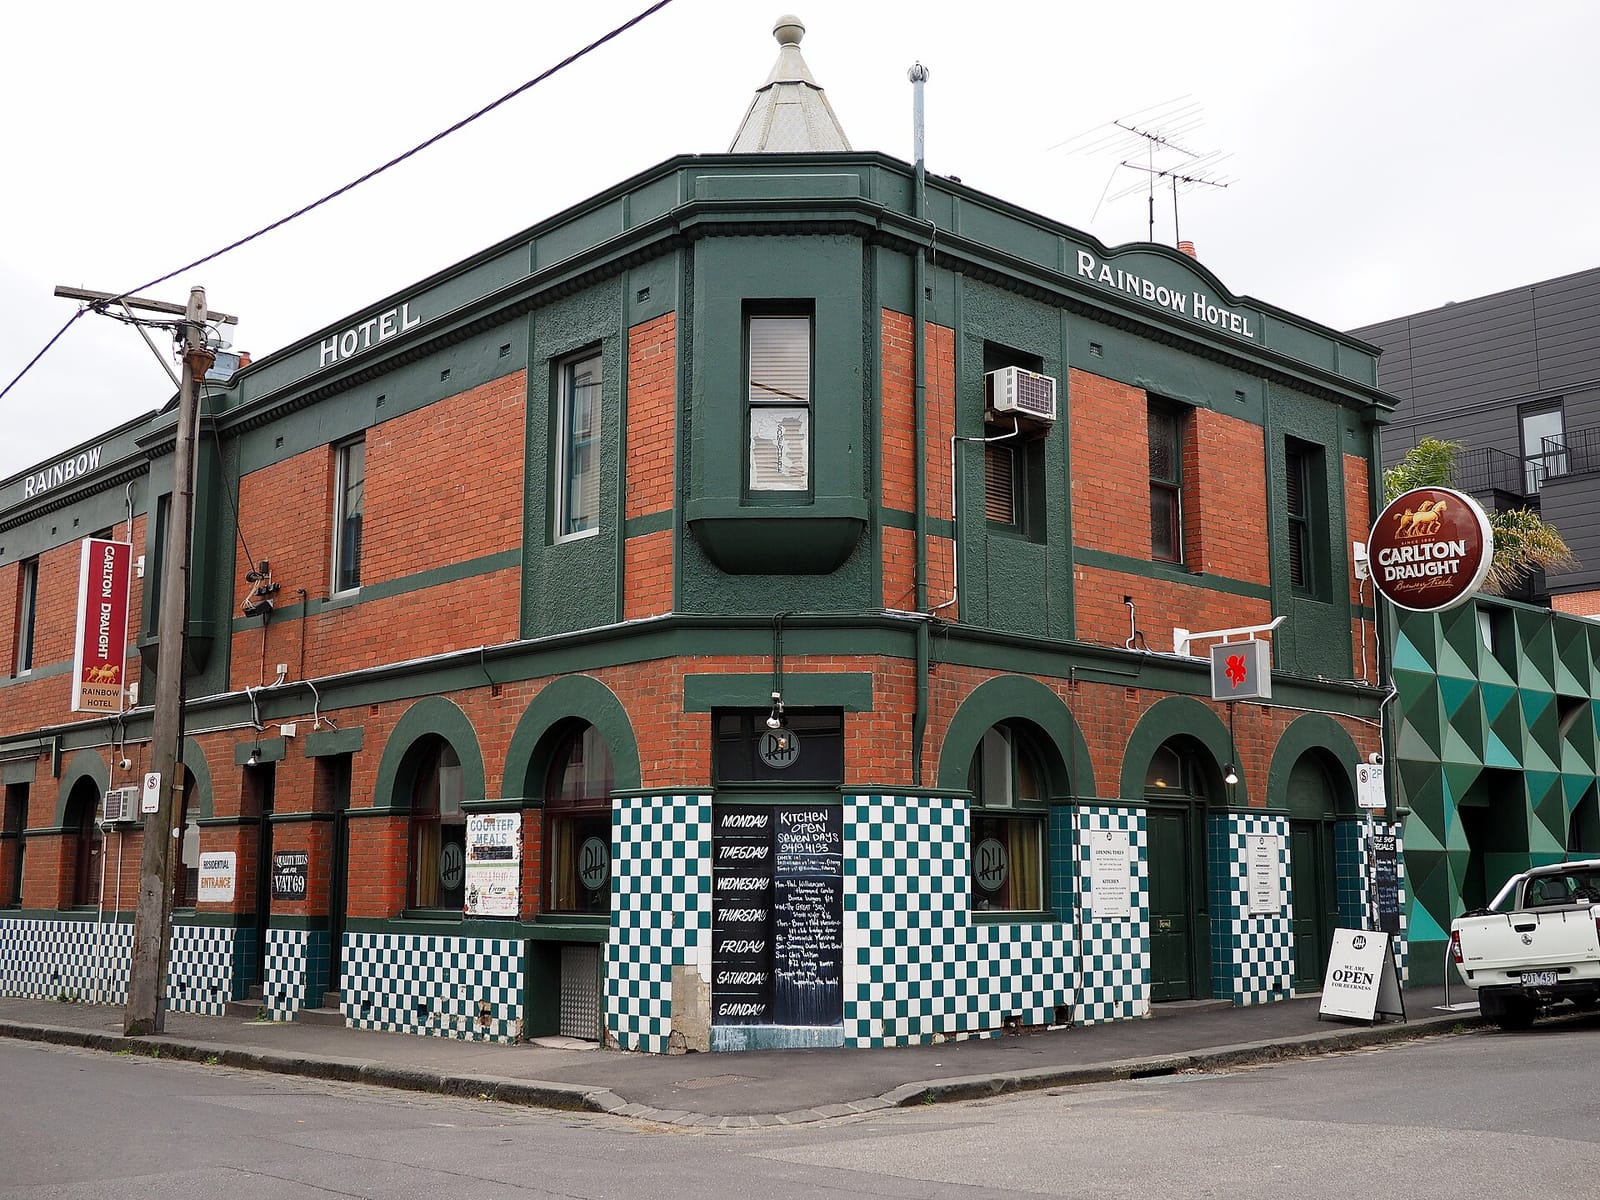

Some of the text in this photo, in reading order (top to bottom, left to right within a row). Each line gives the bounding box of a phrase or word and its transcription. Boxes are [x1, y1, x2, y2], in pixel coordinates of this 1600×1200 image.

[1077, 250, 1254, 337] RAINBOW HOTEL
[319, 303, 421, 368] HOTEL
[23, 446, 103, 499] RAINBOW
[1378, 539, 1466, 566] CARLTON
[1384, 560, 1460, 581] DRAUGHT
[98, 546, 115, 659] CARLTON DRAUGHT
[82, 688, 120, 697] RAINBOW
[87, 699, 113, 708] HOTEL
[721, 815, 768, 828] MONDAY
[780, 809, 828, 825] KITCHEN
[470, 818, 514, 832] COUNTER
[791, 823, 826, 835] OPEN
[476, 833, 507, 845] MEALS
[777, 832, 839, 843] SEVEN DAYS
[720, 846, 769, 859] TUESDAY
[203, 860, 229, 869] RESIDENTIAL
[201, 877, 231, 889] ENTRANCE
[717, 877, 770, 890] WEDNESDAY
[718, 909, 768, 922] THURSDAY
[719, 940, 765, 953] FRIDAY
[717, 971, 768, 985] SATURDAY
[1332, 969, 1374, 986] OPEN
[719, 1003, 766, 1017] SUNDAY
